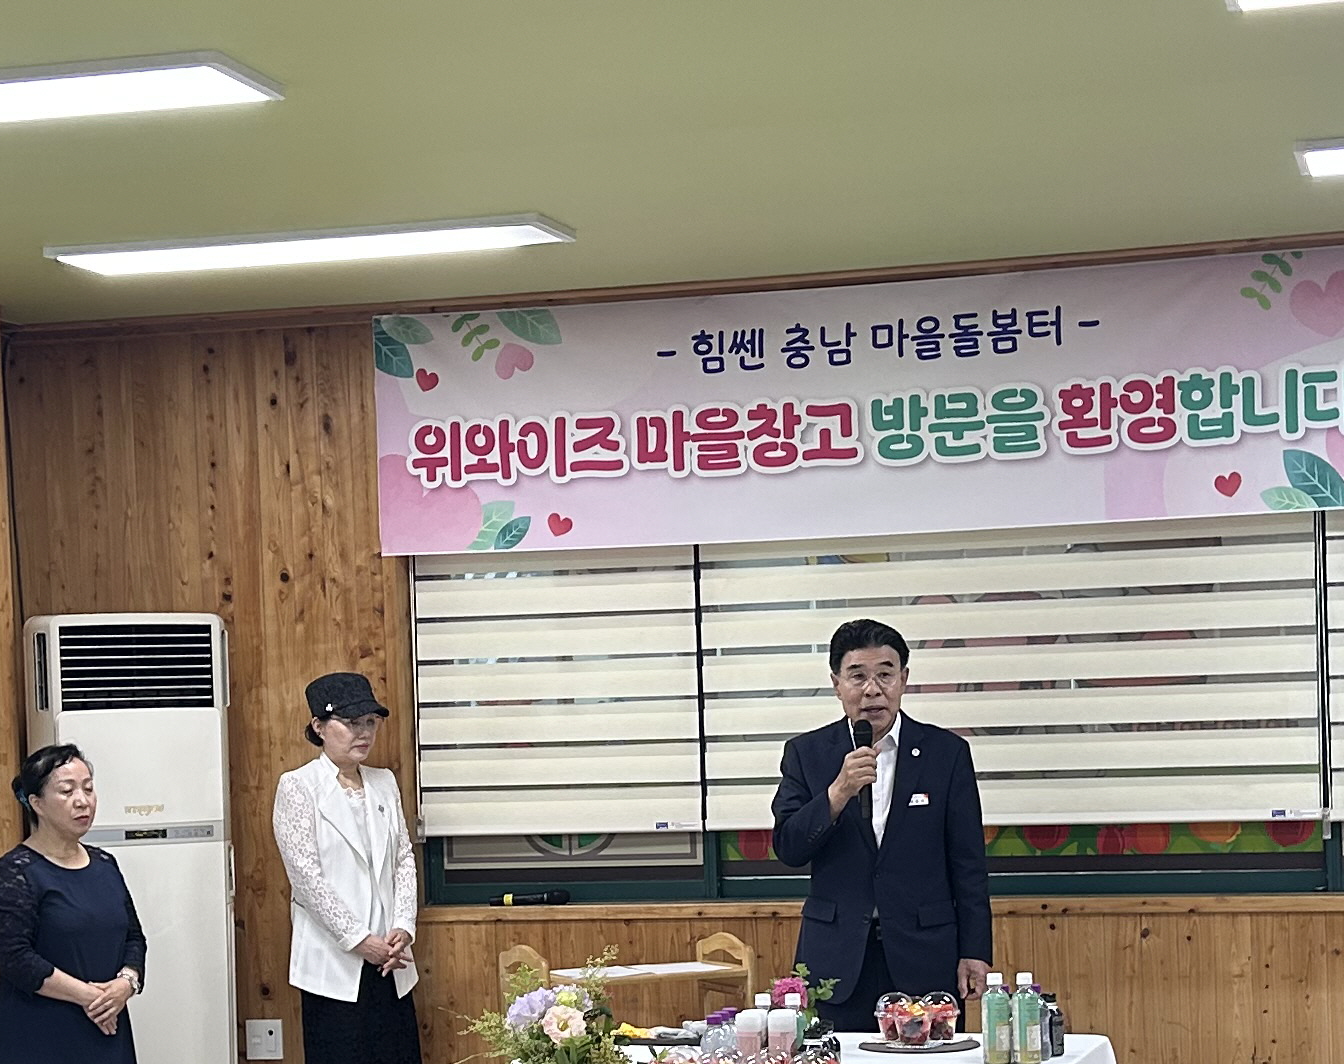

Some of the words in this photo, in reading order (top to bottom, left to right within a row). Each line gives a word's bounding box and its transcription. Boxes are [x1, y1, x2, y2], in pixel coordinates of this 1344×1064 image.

[691, 329, 764, 374] 힘쎈
[781, 323, 856, 368] 충남
[871, 306, 1062, 361] 마을돌봄터
[412, 417, 624, 482] 위와이즈
[636, 403, 857, 472] 마을창고
[871, 387, 1044, 460] 방문을
